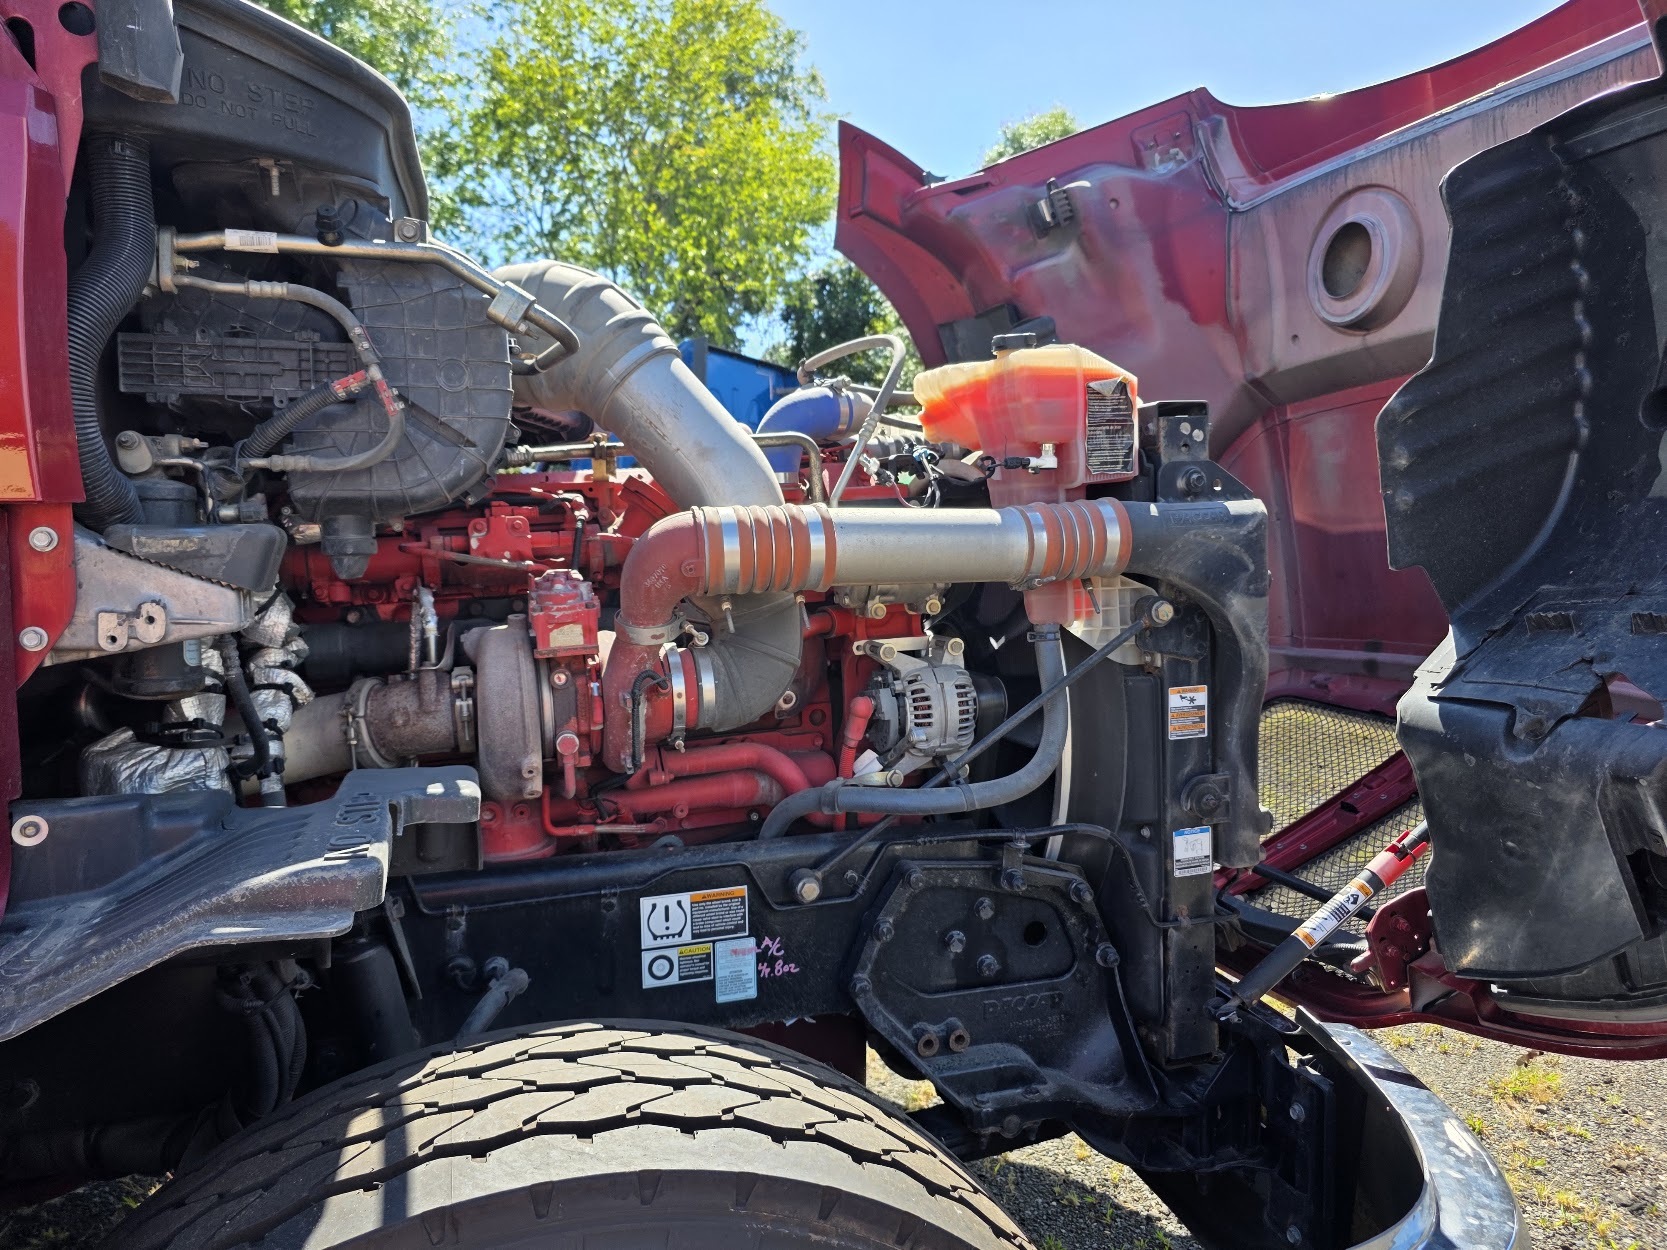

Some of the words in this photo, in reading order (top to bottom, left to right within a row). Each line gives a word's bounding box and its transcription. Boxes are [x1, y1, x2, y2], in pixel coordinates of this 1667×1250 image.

[187, 67, 226, 94] NO
[247, 83, 315, 116] STEP
[181, 92, 207, 108] DO
[221, 99, 259, 120] NOT
[272, 112, 317, 138] PULL
[323, 834, 373, 862] NO
[706, 890, 735, 899] WARNING
[683, 945, 711, 956] CAUTION
[761, 936, 785, 956] A/C
